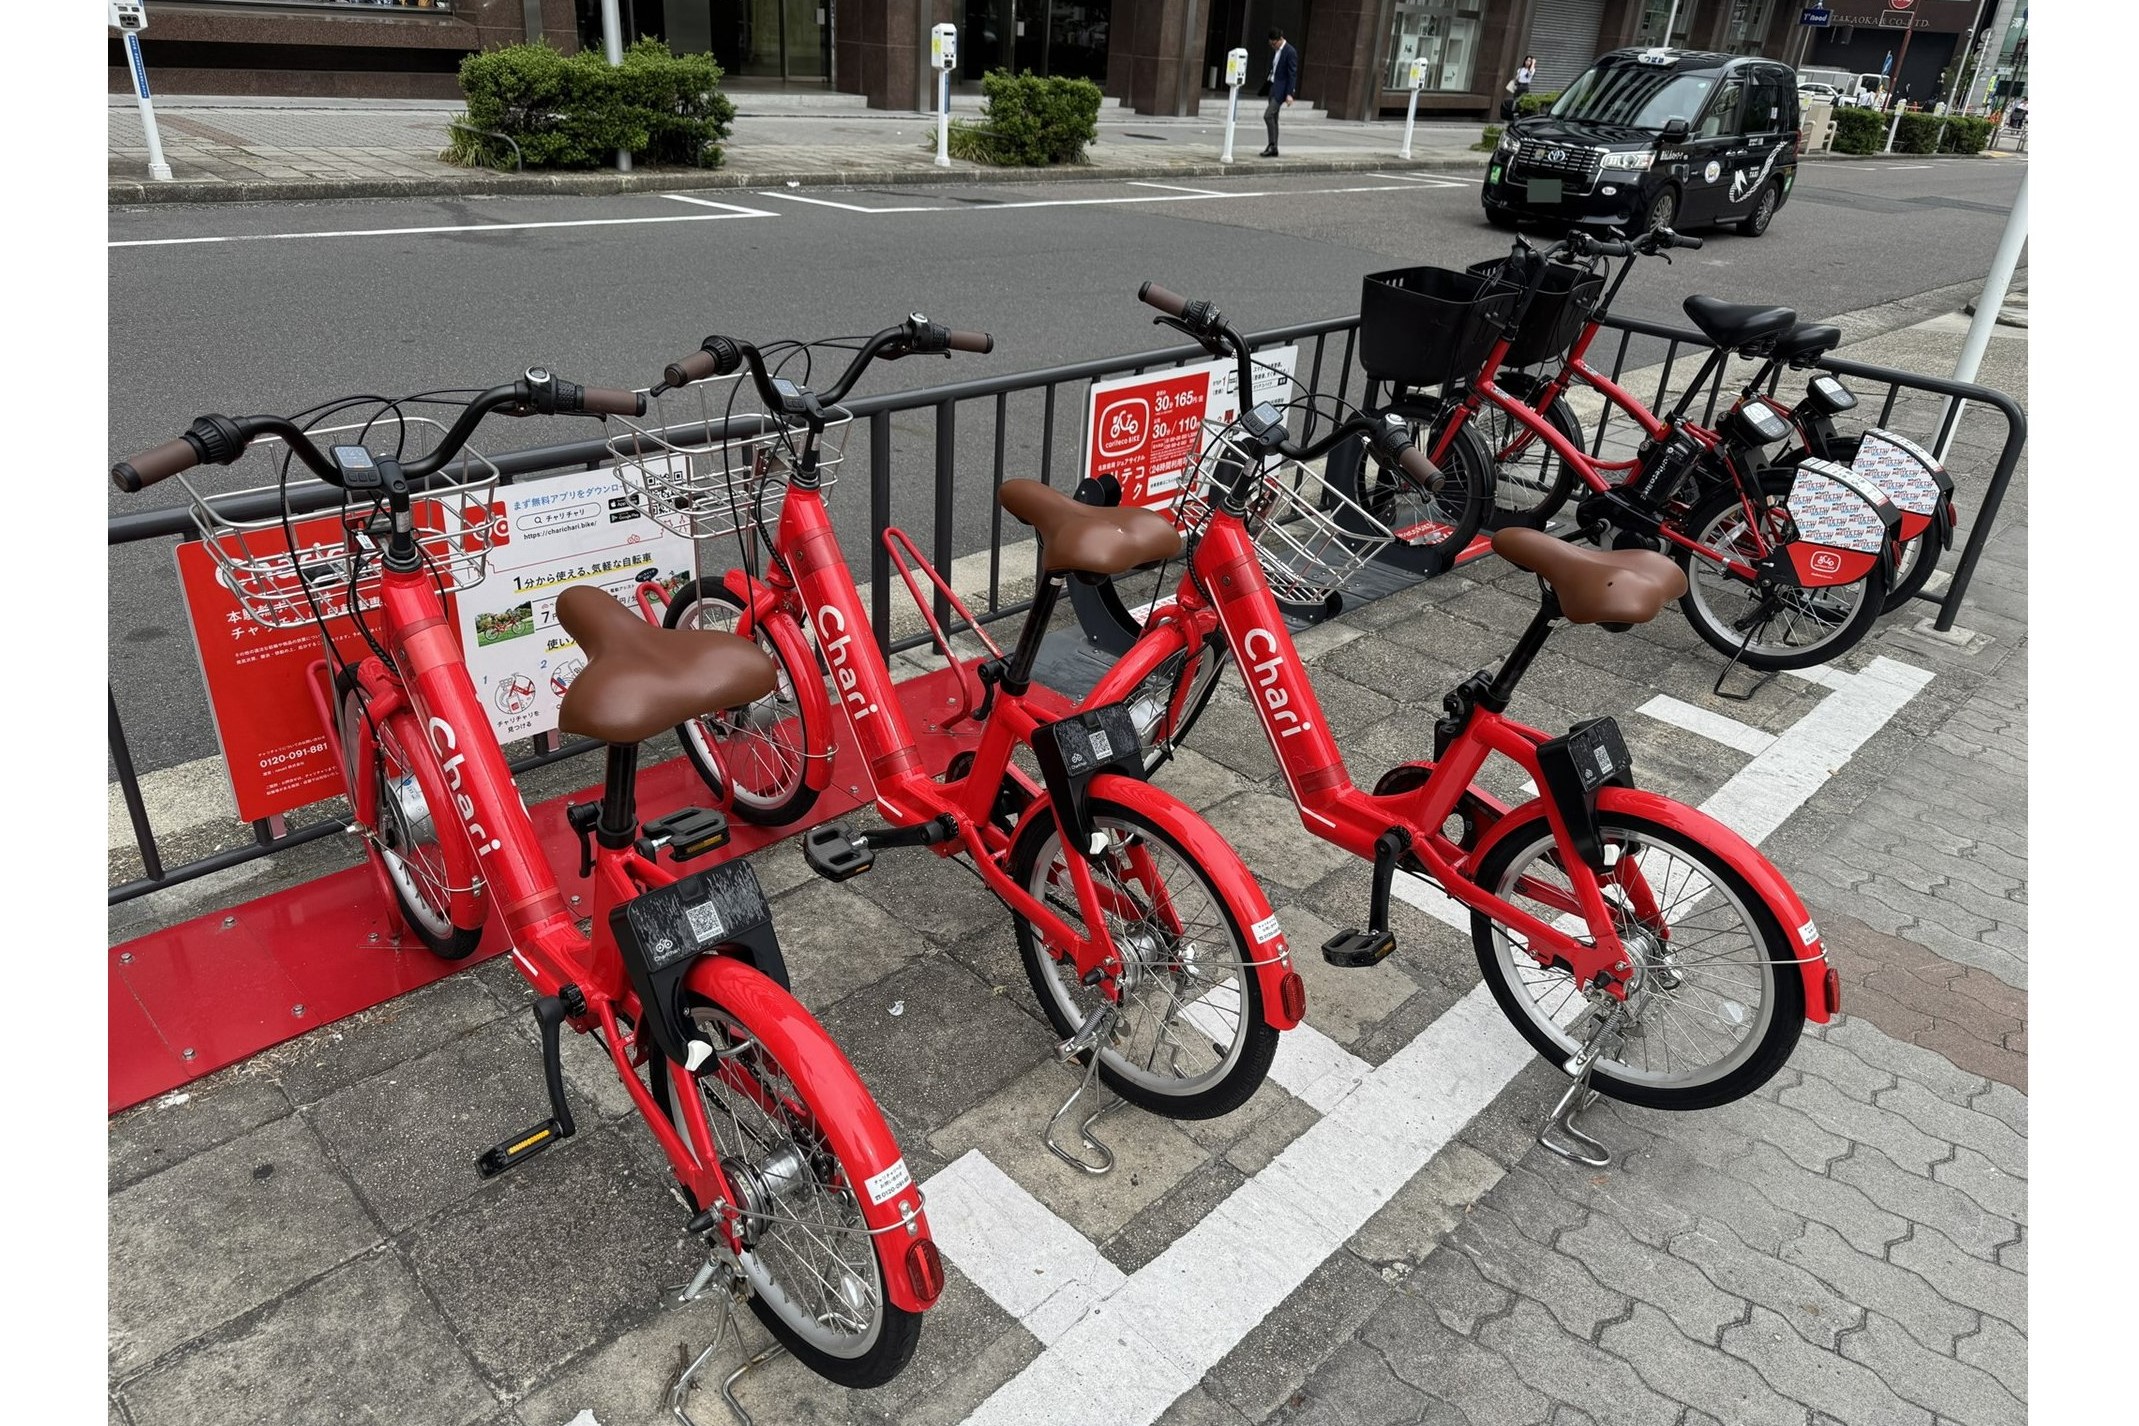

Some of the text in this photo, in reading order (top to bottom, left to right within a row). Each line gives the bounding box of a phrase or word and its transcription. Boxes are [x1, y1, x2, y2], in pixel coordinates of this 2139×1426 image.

[546, 509, 585, 522] チャリチャリ
[524, 520, 598, 540] https://charichari.bike/
[513, 552, 653, 590] 1分から使える、気軽な自転車
[547, 638, 575, 651] 使い
[540, 660, 548, 669] 2
[818, 604, 878, 720] Chari
[483, 675, 488, 684] 1
[1244, 627, 1311, 738] Chari
[259, 742, 328, 768] 0120-091-881
[429, 716, 501, 857] Chari
